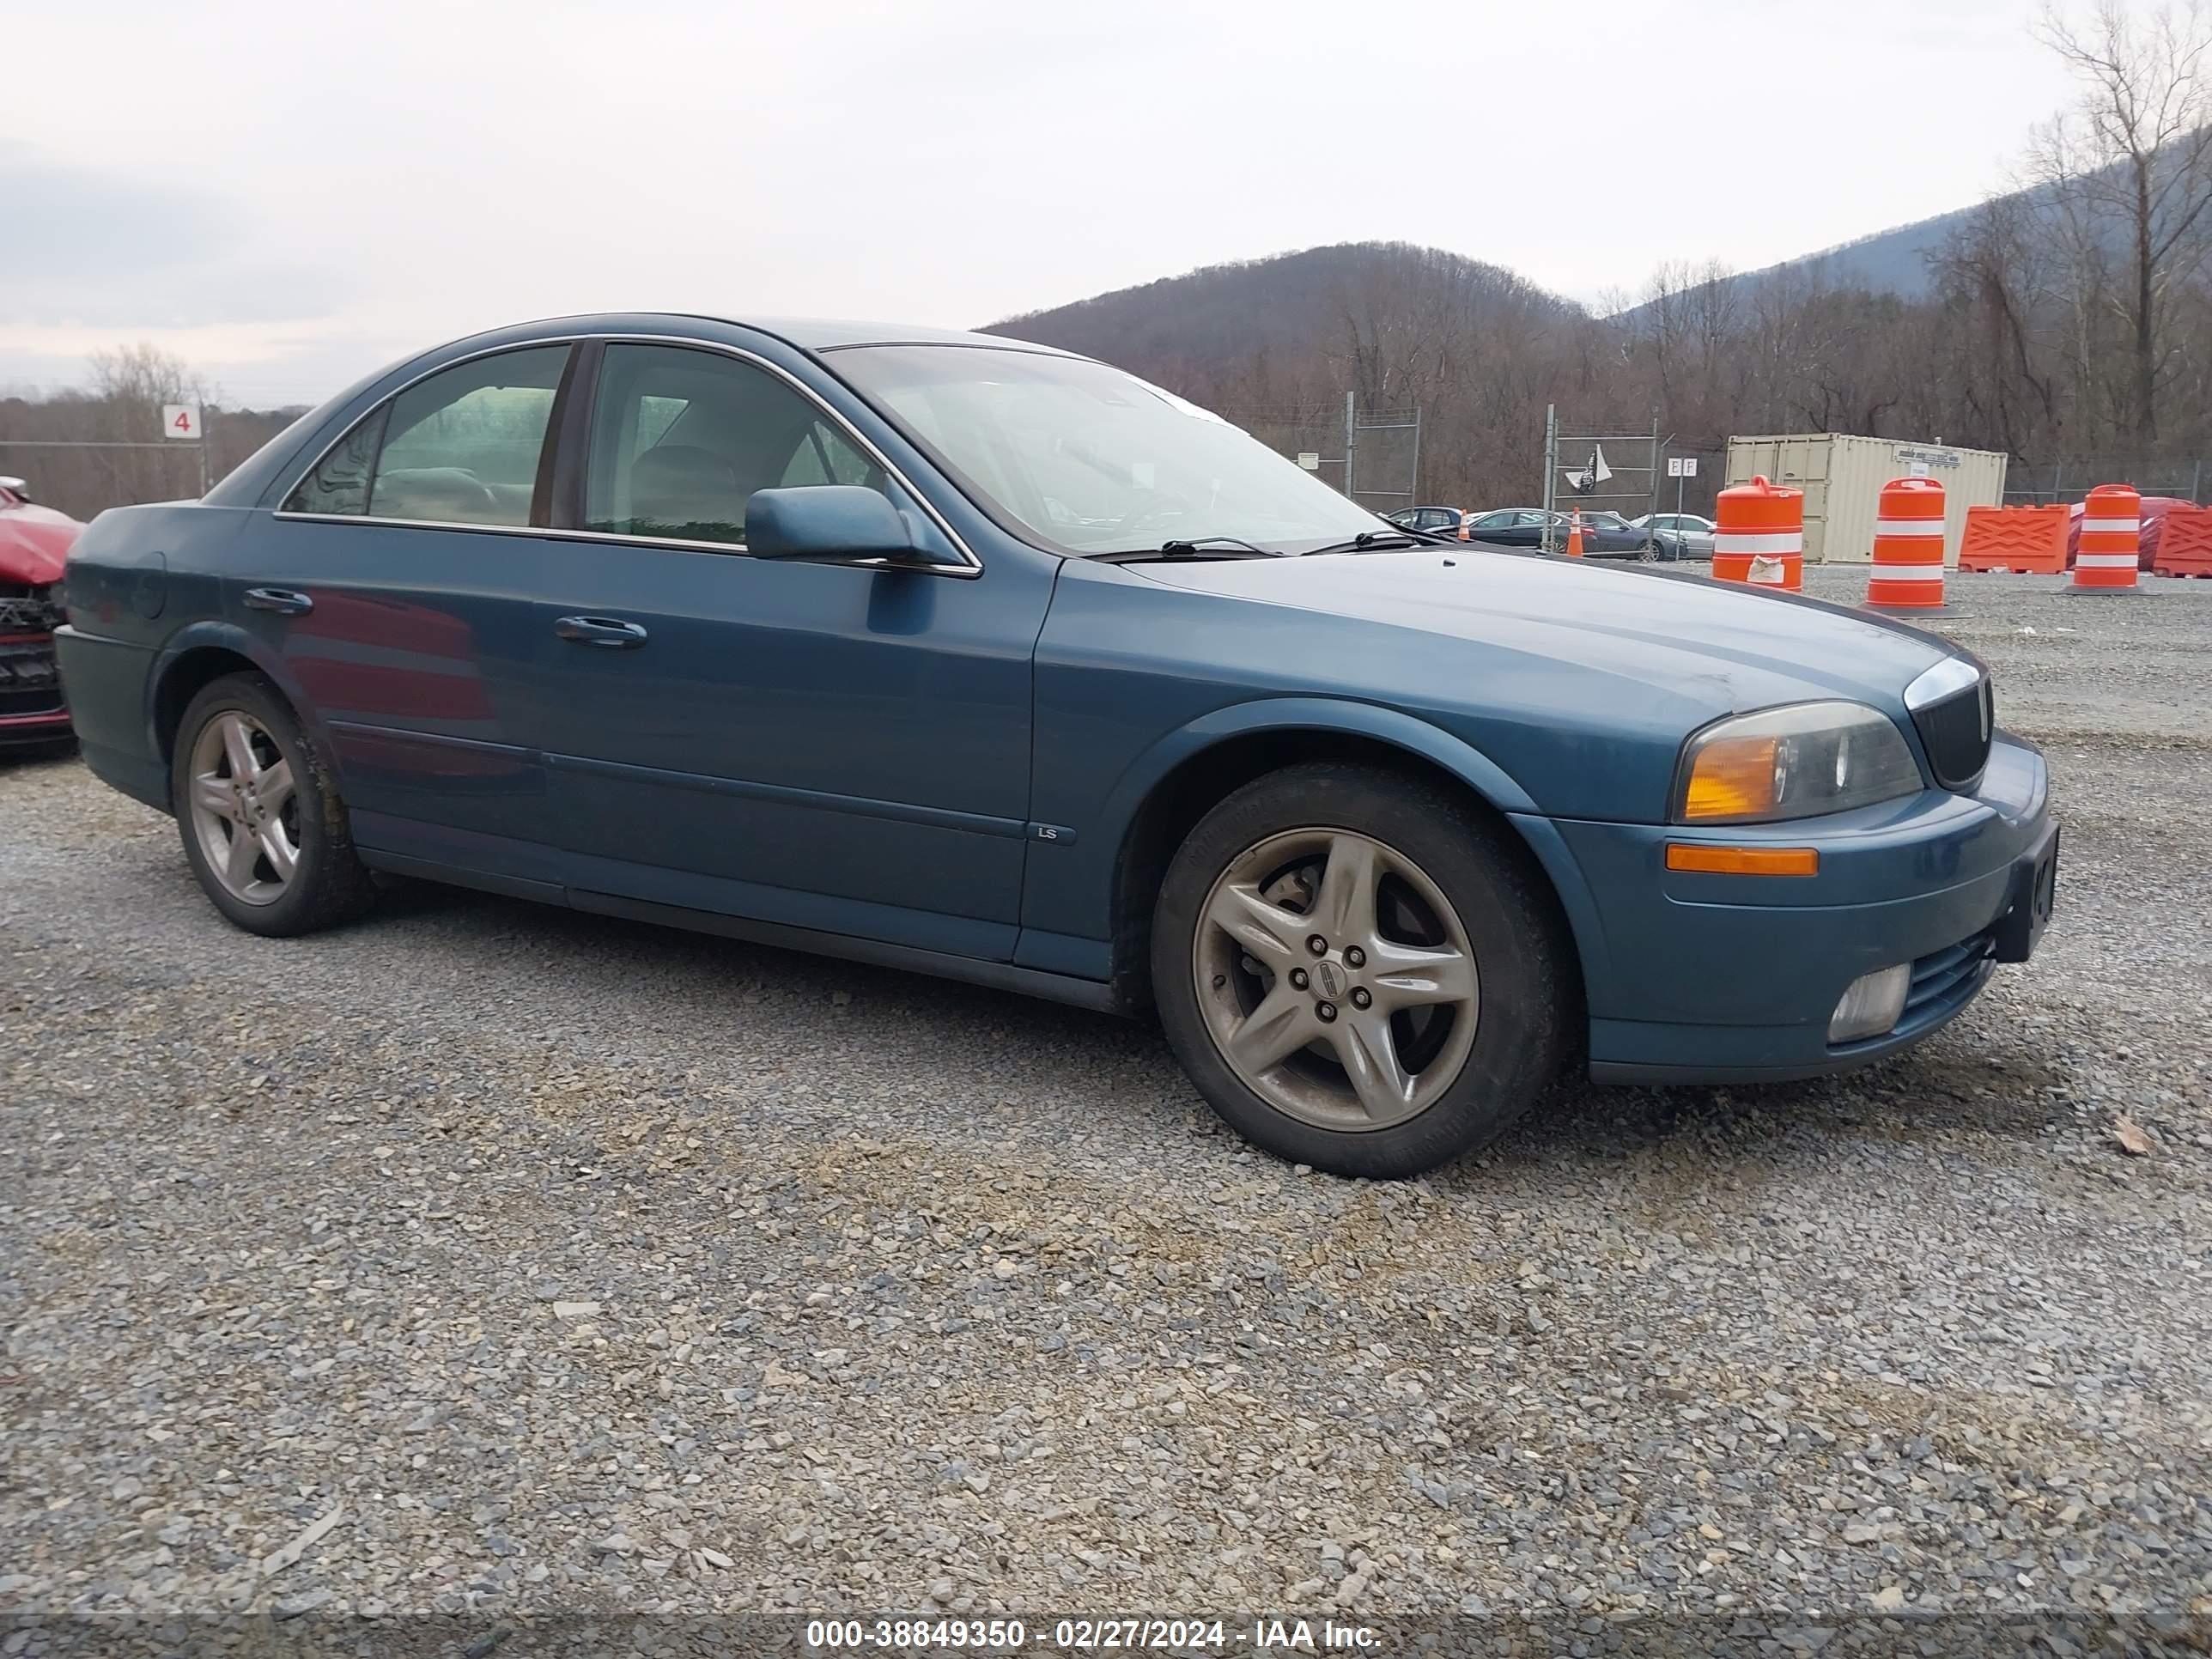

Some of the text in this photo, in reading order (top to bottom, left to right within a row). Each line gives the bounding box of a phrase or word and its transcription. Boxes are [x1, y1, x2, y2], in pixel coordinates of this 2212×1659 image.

[174, 412, 191, 431] 4
[1672, 460, 1679, 473] E
[1687, 461, 1695, 474] F
[1038, 827, 1058, 839] LS
